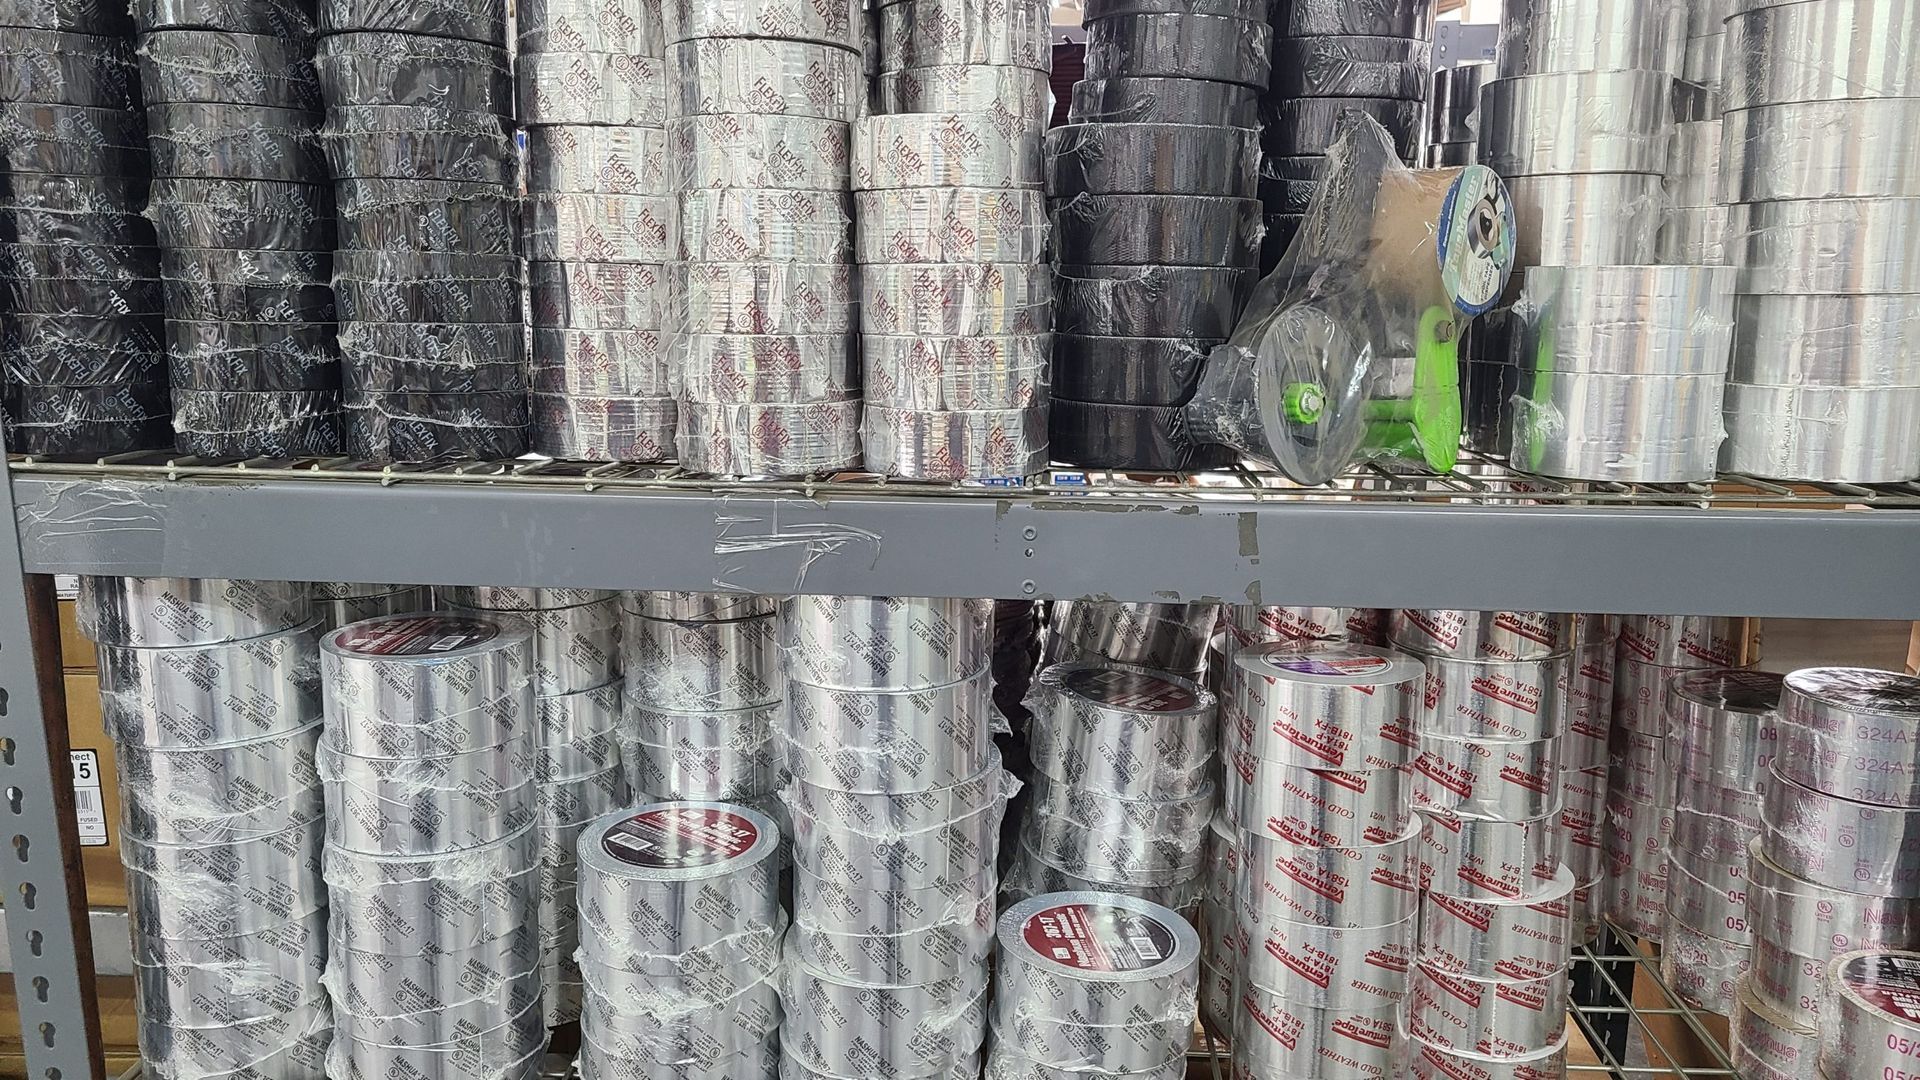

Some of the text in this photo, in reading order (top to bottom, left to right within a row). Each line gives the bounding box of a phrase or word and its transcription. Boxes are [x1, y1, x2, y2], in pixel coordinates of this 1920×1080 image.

[604, 0, 638, 37] FLEXFIX
[932, 5, 962, 39] FLEXFIX
[555, 15, 586, 51] FLEXFIX
[570, 59, 602, 93] FLEXFIX
[808, 61, 836, 98] FLEXFIX
[754, 76, 789, 114] FLEXFIX
[72, 110, 108, 149] FLEXFIX
[250, 121, 283, 160] FLEXFIX
[825, 125, 845, 162] FLEXFIX
[893, 135, 925, 171] FLEXFIX
[607, 154, 641, 189] FLEXFIX
[776, 140, 807, 177] FLEXFIX
[997, 192, 1023, 229] FLEXFIX
[430, 208, 462, 247] FLEXFIX
[585, 224, 618, 258] FLEXFIX
[717, 219, 750, 254] FLEXFIX
[944, 211, 978, 247] FLEXFIX
[574, 270, 605, 302] FLEXFIX
[796, 281, 825, 316] FLEXFIX
[875, 289, 899, 325] FLEXFIX
[580, 337, 609, 371] FLEXFIX
[771, 337, 803, 371] FLEXFIX
[913, 339, 944, 376] FLEXFIX
[717, 355, 748, 391] FLEXFIX
[874, 358, 896, 395] FLEXFIX
[758, 411, 793, 448] FLEXFIX
[162, 591, 213, 630] NASHUA 367-17
[549, 610, 568, 627] 367-17
[1538, 615, 1561, 630] 1581A
[1298, 616, 1327, 635] 1581A
[1433, 616, 1463, 635] 181A-P
[1496, 612, 1558, 644] VentureTape
[576, 633, 594, 651] NASHUA
[909, 622, 949, 660] NASHUA 367-17
[843, 636, 889, 677] NASHUA 367-17
[162, 654, 213, 694] NASHUA 367-17
[446, 676, 471, 697] NASHUA
[388, 679, 413, 700] NASHUA
[1472, 677, 1539, 710] VentureTape
[1516, 681, 1543, 697] 1581A
[223, 697, 272, 732] NASHUA 367-17
[842, 703, 866, 730] NASHUA
[907, 694, 931, 715] NASHUA
[1280, 706, 1299, 720] IV/21
[1315, 718, 1354, 741] 181B-FX
[1457, 704, 1527, 739] COLD WEATHER
[1857, 726, 1907, 743] 324A
[681, 737, 702, 758] NASHUA
[1273, 719, 1344, 761] VentureTape
[1317, 733, 1349, 751] 181A-P
[1465, 742, 1492, 758] COLD
[1507, 752, 1525, 763] IV/21
[1854, 757, 1904, 775] 324A
[235, 775, 260, 795] NASHUA
[830, 765, 853, 791] NASHUA
[1112, 762, 1132, 785] NASHUA
[1447, 762, 1478, 783] 1581A
[472, 797, 497, 815] NASHUA
[1282, 780, 1355, 819] COLD WEATHER
[1852, 788, 1900, 804] 324A
[854, 800, 874, 822] 367-17
[360, 816, 383, 844] NASHUA
[410, 817, 435, 840] NASHUA
[1311, 828, 1342, 846] 1581A
[825, 835, 863, 882] NASHUA 367-17
[1424, 836, 1448, 854] COLD
[1465, 852, 1484, 865] IV/21
[184, 849, 207, 870] 367-17
[907, 852, 927, 869] 367-17
[1276, 856, 1344, 899] VentureTape
[1319, 867, 1349, 887] 1581A
[434, 881, 480, 913] NASHUA 367-17
[702, 884, 723, 902] NASHUA
[842, 893, 861, 916] 367-17
[1264, 881, 1331, 926] COLD WEATHER
[265, 902, 290, 920] NASHUA
[372, 894, 415, 936] NASHUA 367-17
[638, 898, 681, 938] NASHUA 367-17
[903, 899, 924, 915] 367-17
[1463, 901, 1494, 918] 181A-P
[257, 930, 303, 959] NASHUA 367-17
[1270, 925, 1287, 940] IV/21
[1512, 923, 1548, 940] WEATHER
[467, 957, 489, 977] NASHUA
[1265, 937, 1330, 985] VentureTape
[1302, 942, 1339, 966] 181B-FX
[1304, 957, 1334, 975] 181A-P
[1432, 943, 1468, 969] 181B-FX
[402, 977, 427, 999] NASHUA
[1047, 974, 1064, 997] 367-17
[1351, 979, 1388, 997] WEATHER
[1524, 986, 1548, 996] 181A-P
[811, 977, 847, 1025] NASHUA 367-17
[889, 998, 910, 1016] 367-17
[1243, 993, 1296, 1046] VentureTape
[1271, 1002, 1305, 1029] 181B-FX
[1273, 1016, 1301, 1038] 181A-P
[1372, 1018, 1395, 1031] 1581A
[1442, 1010, 1468, 1029] COLD
[1072, 1009, 1112, 1051] NASHUA 367-17
[1332, 1018, 1392, 1045] VentureTape
[204, 1040, 224, 1057] 367-17
[804, 1032, 823, 1060] NASHUA
[855, 1036, 898, 1076] NASHUA 367-17
[1494, 1036, 1527, 1053] 181B-FX
[1317, 1046, 1382, 1074] COLD WEATHER
